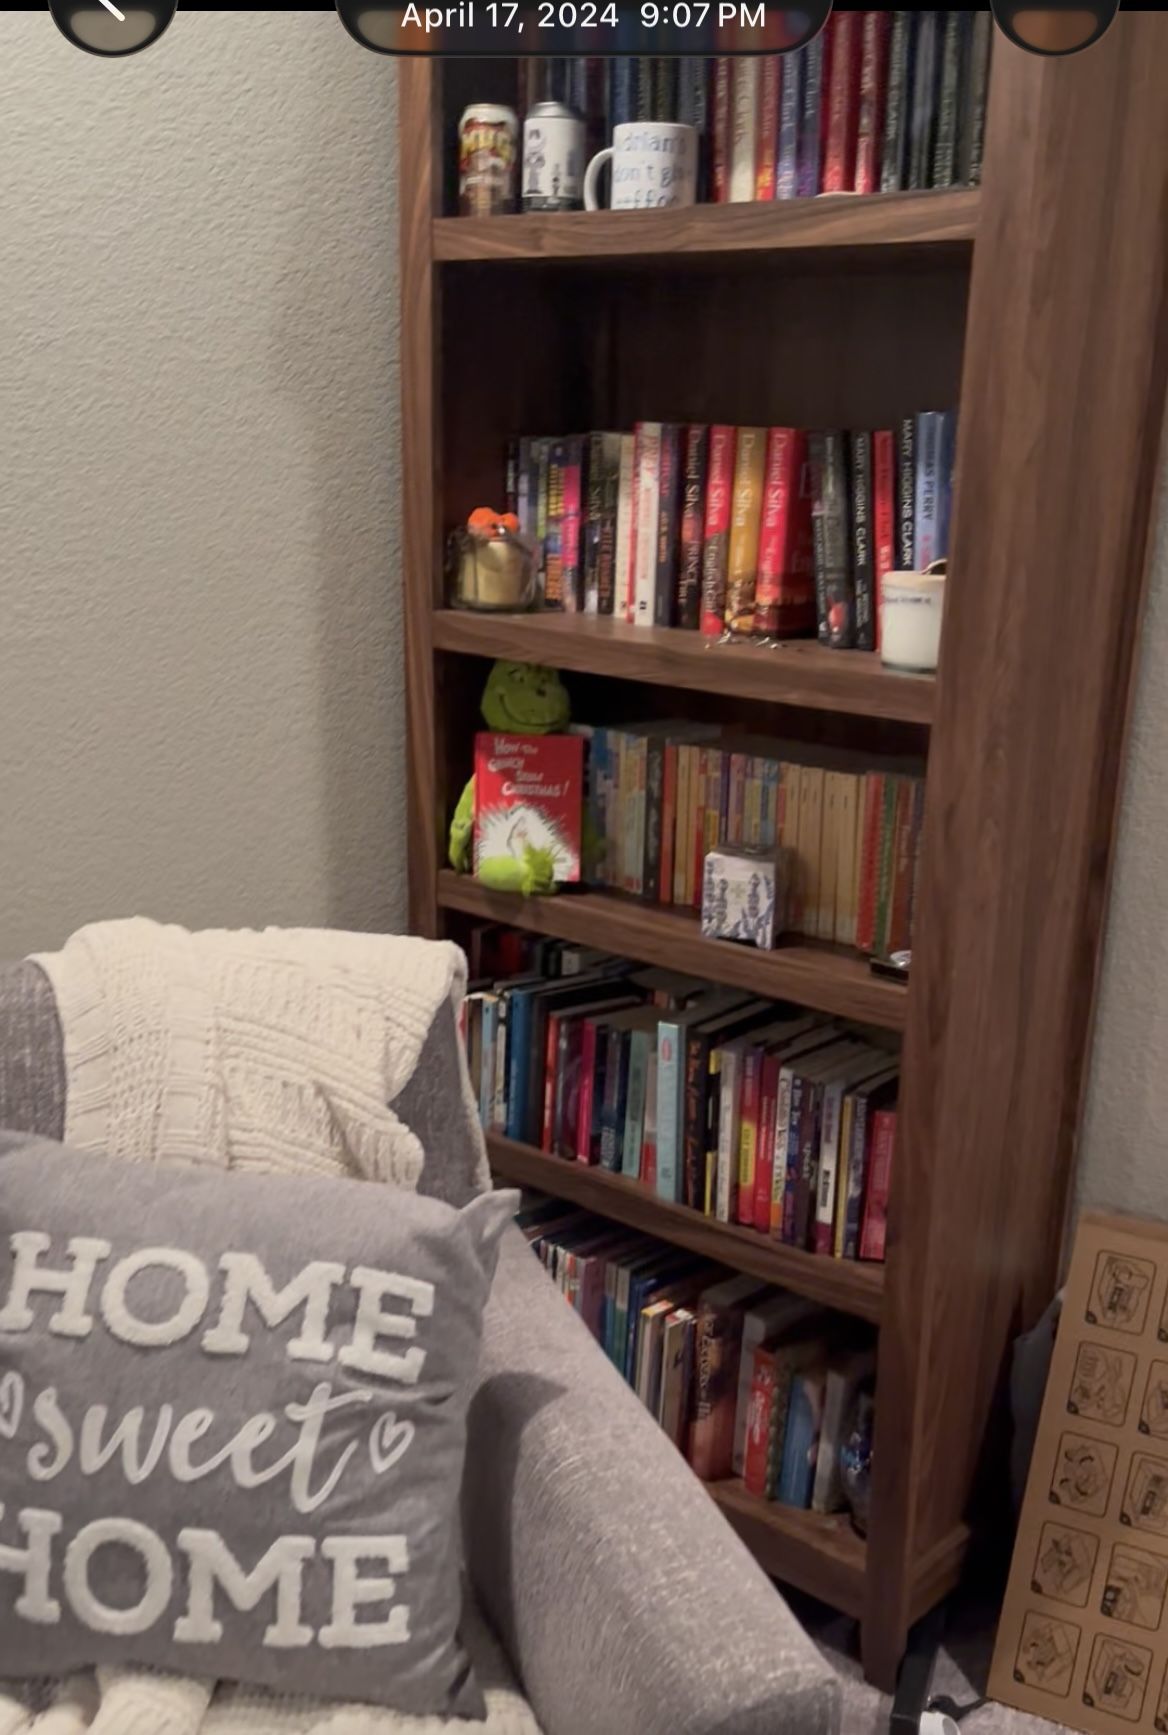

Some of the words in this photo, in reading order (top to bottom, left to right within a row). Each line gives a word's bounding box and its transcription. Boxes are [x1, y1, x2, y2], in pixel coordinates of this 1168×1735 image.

[687, 429, 704, 478] Daniel
[712, 434, 727, 485] Daniel
[739, 433, 756, 485] Daniel
[770, 433, 788, 485] Daniel
[856, 437, 866, 470] MARY
[902, 420, 914, 458] MARY
[683, 483, 701, 518] Silva
[708, 488, 725, 526] Silva
[735, 487, 753, 527] Silva
[765, 487, 787, 528] Silva
[855, 474, 867, 523] HIGGINS
[901, 462, 914, 519] HIGGINS
[921, 480, 936, 521] PERRY
[855, 527, 867, 567] CLARK
[902, 521, 914, 566] CLARK
[0, 1231, 435, 1384] HOME
[26, 1382, 372, 1512] sweet
